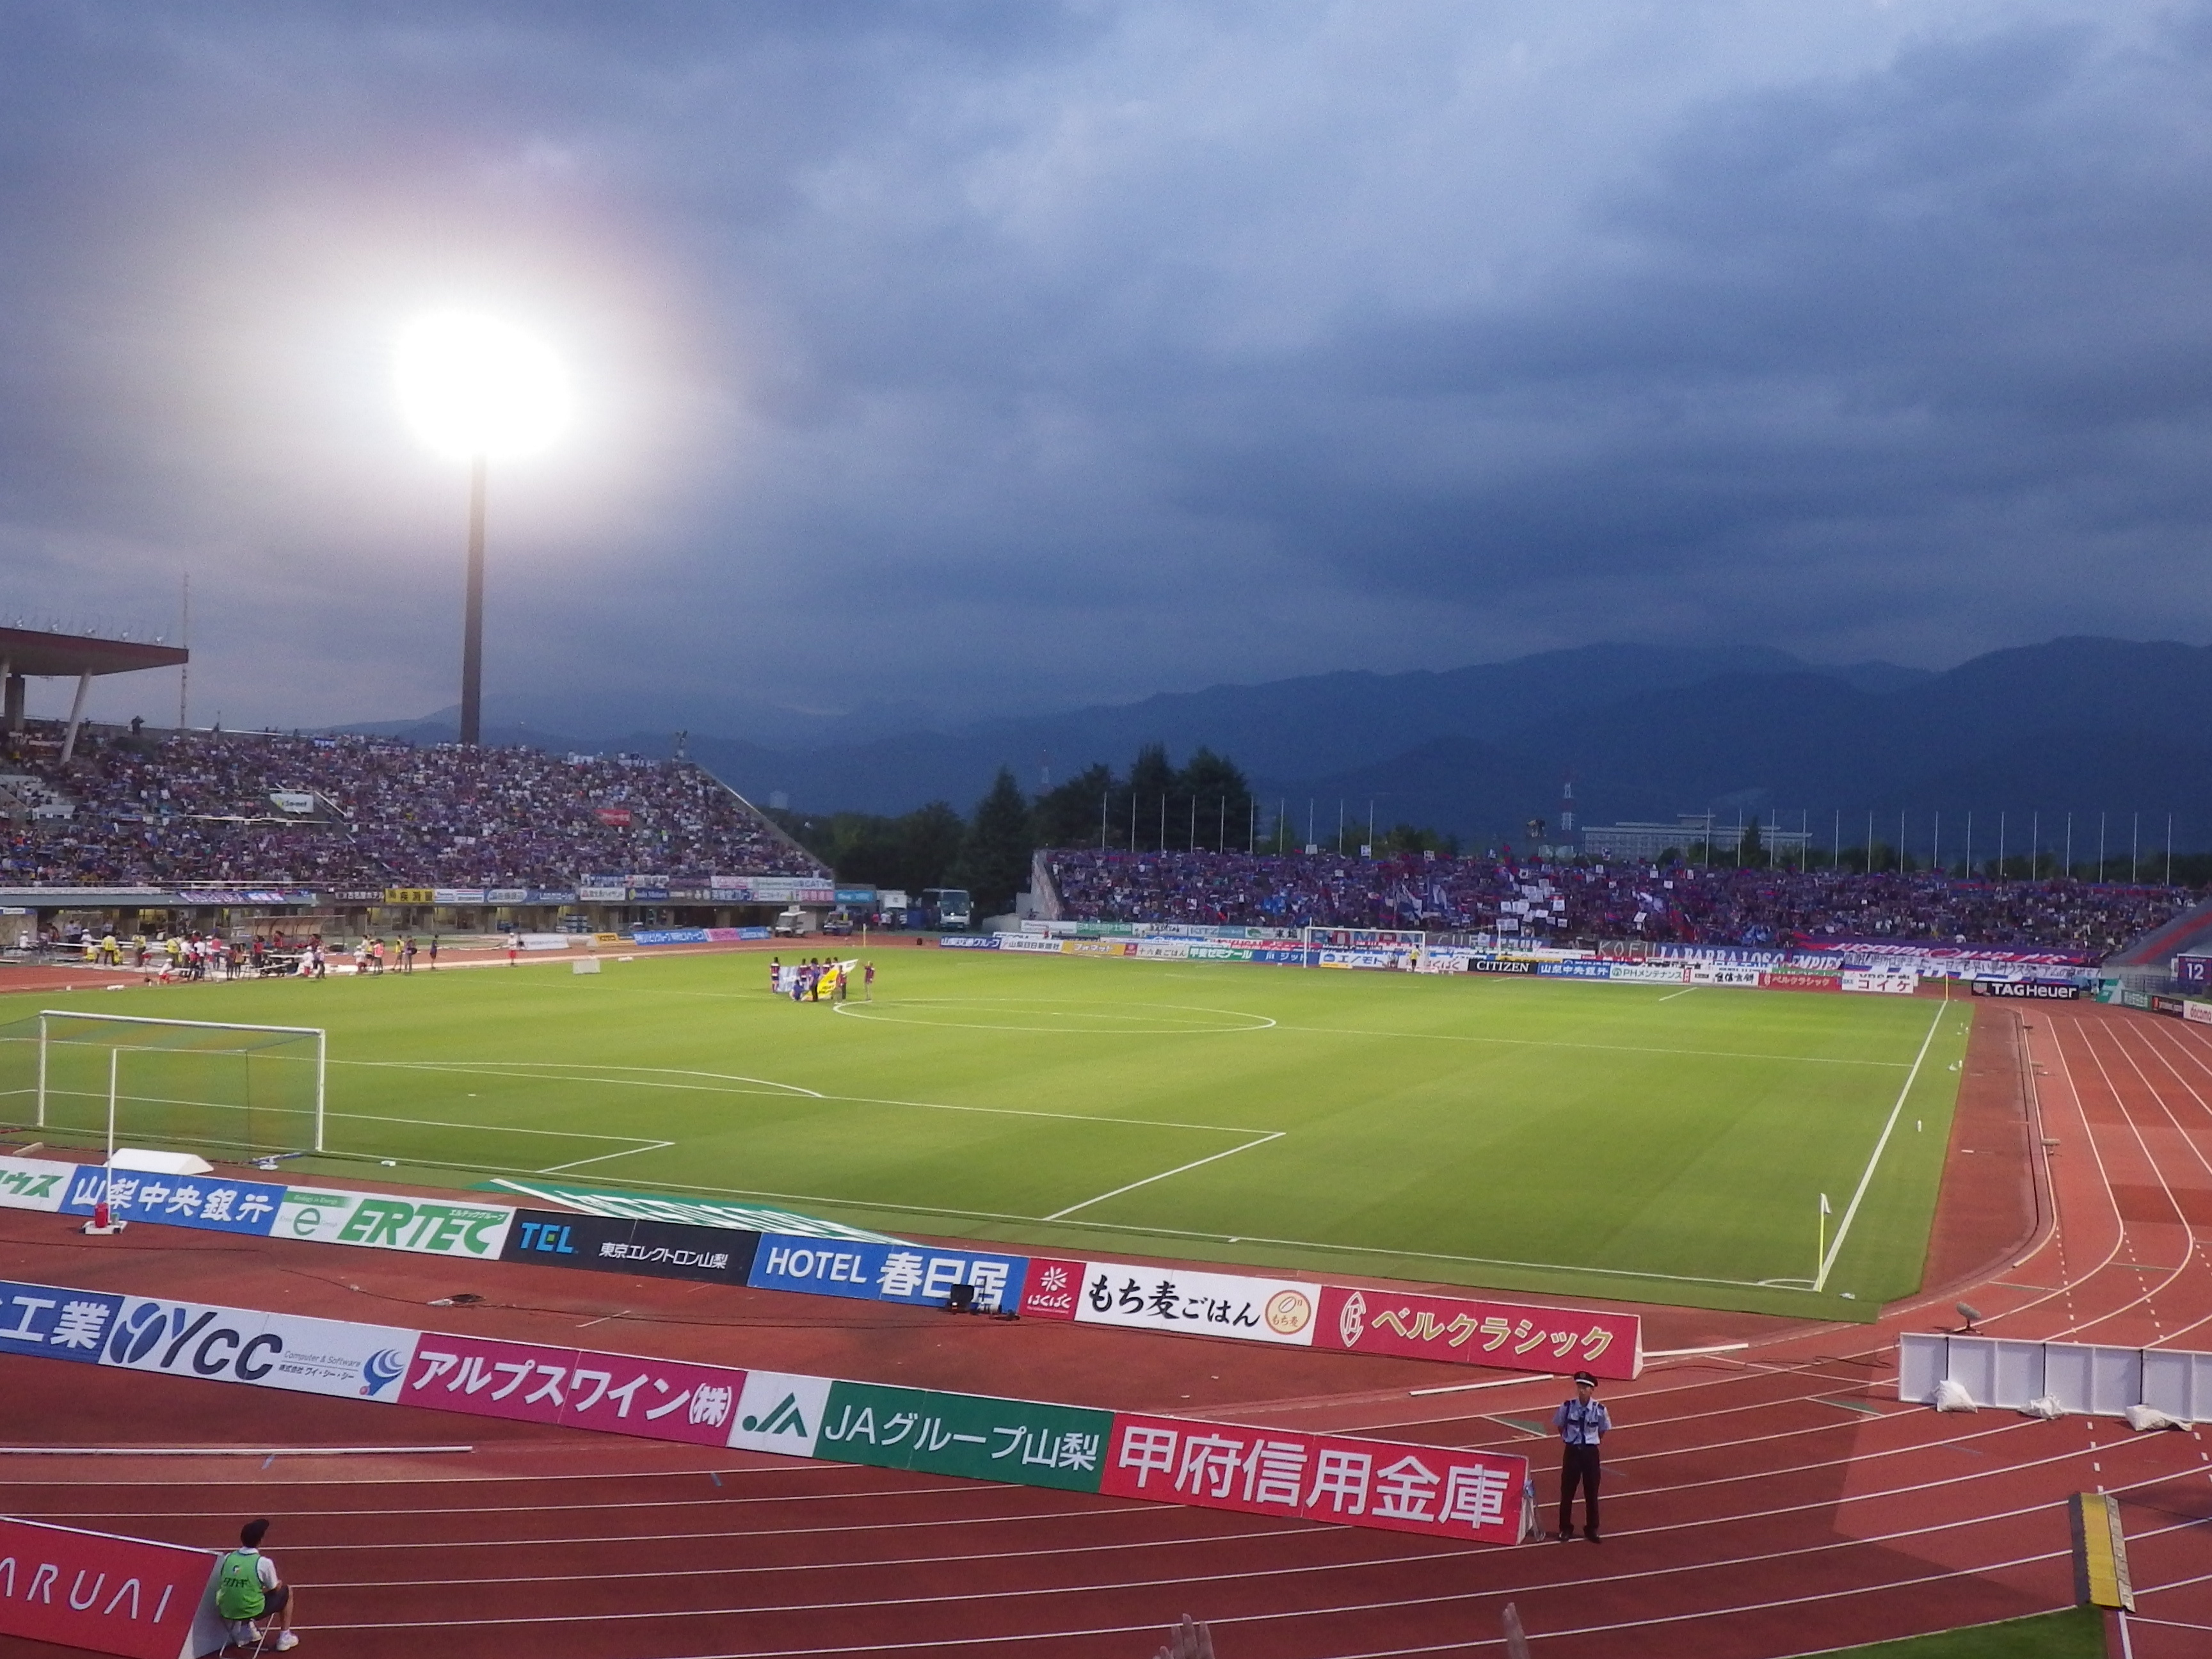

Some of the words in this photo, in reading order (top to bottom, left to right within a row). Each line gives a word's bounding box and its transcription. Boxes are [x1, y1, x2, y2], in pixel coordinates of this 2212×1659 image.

[1009, 941, 1061, 950] 山梨日日新聞社
[1476, 961, 1530, 972] CITIZEN
[1541, 964, 1608, 976] 山梨中央銀行
[2187, 963, 2204, 981] 12
[1772, 976, 1831, 986] ベルクラシック
[1858, 979, 1911, 991] コイケ
[1991, 983, 2024, 997] TAG
[2026, 985, 2077, 998] Heuer
[72, 1176, 273, 1223] 山梨中央銀行
[337, 1198, 511, 1254] ERTEC
[520, 1222, 575, 1254] TEL
[598, 1242, 729, 1270] 東京エレクトロン山梨
[765, 1247, 867, 1283] HOTEL
[876, 1252, 1009, 1311] 春日居
[1027, 1294, 1072, 1309] はくばく
[1089, 1274, 1262, 1327] もち麦ごはん
[0, 1295, 110, 1350] 工業
[1272, 1314, 1299, 1327] もち麦
[1372, 1307, 1614, 1361] ベルクラシック
[160, 1308, 284, 1381] YCC
[285, 1351, 319, 1363] Computer
[328, 1356, 361, 1367] Software
[825, 1404, 1100, 1471] JAグループ山梨
[1118, 1425, 1511, 1530] 甲府信用金庫
